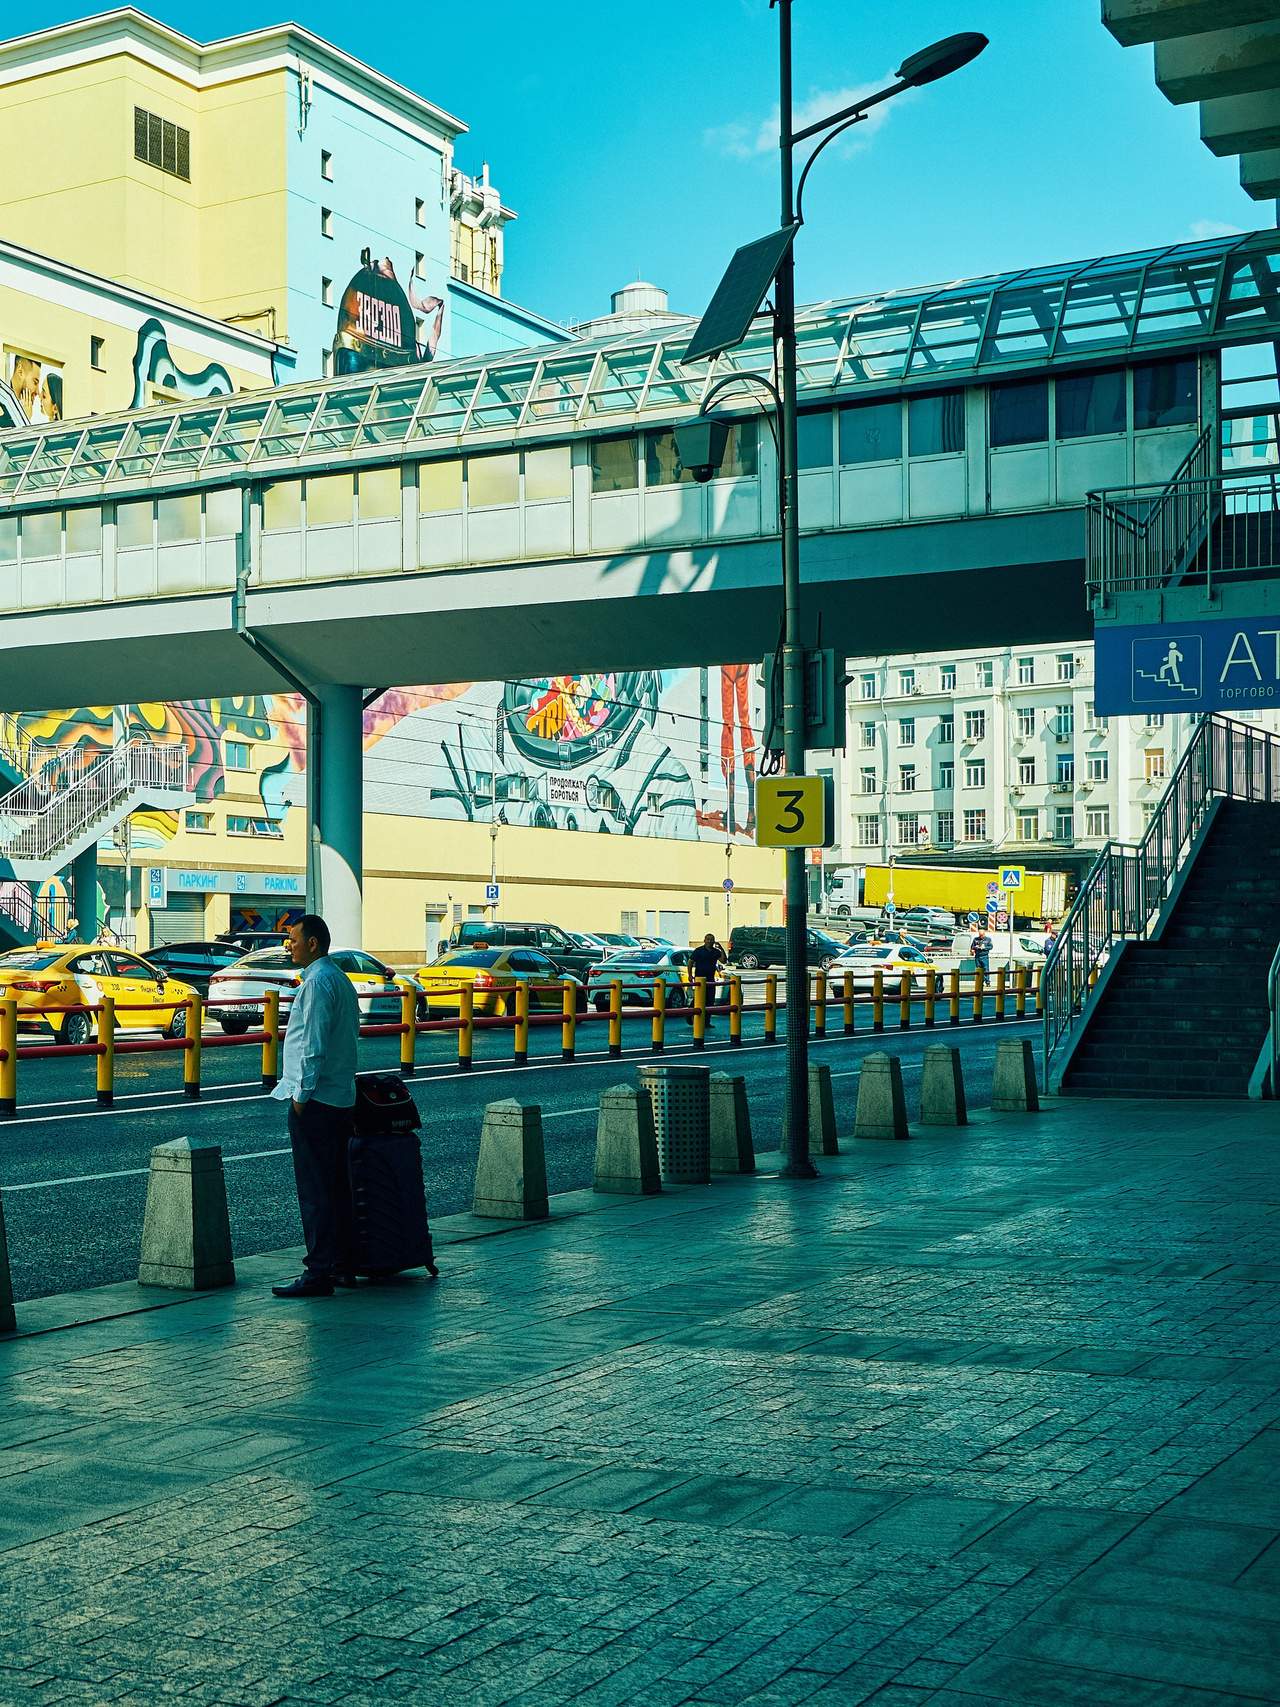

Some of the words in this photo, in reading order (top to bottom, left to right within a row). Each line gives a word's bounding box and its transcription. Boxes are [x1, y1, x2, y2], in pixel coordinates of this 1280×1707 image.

[1220, 686, 1280, 699] ТОРГОВО-
[549, 776, 587, 790] ПРОДОЛЖАТЬ
[550, 788, 579, 802] БОРОТЬСЯ
[774, 790, 805, 833] 3
[179, 873, 219, 889] ПАРКИНГ
[264, 877, 298, 891] PARKING
